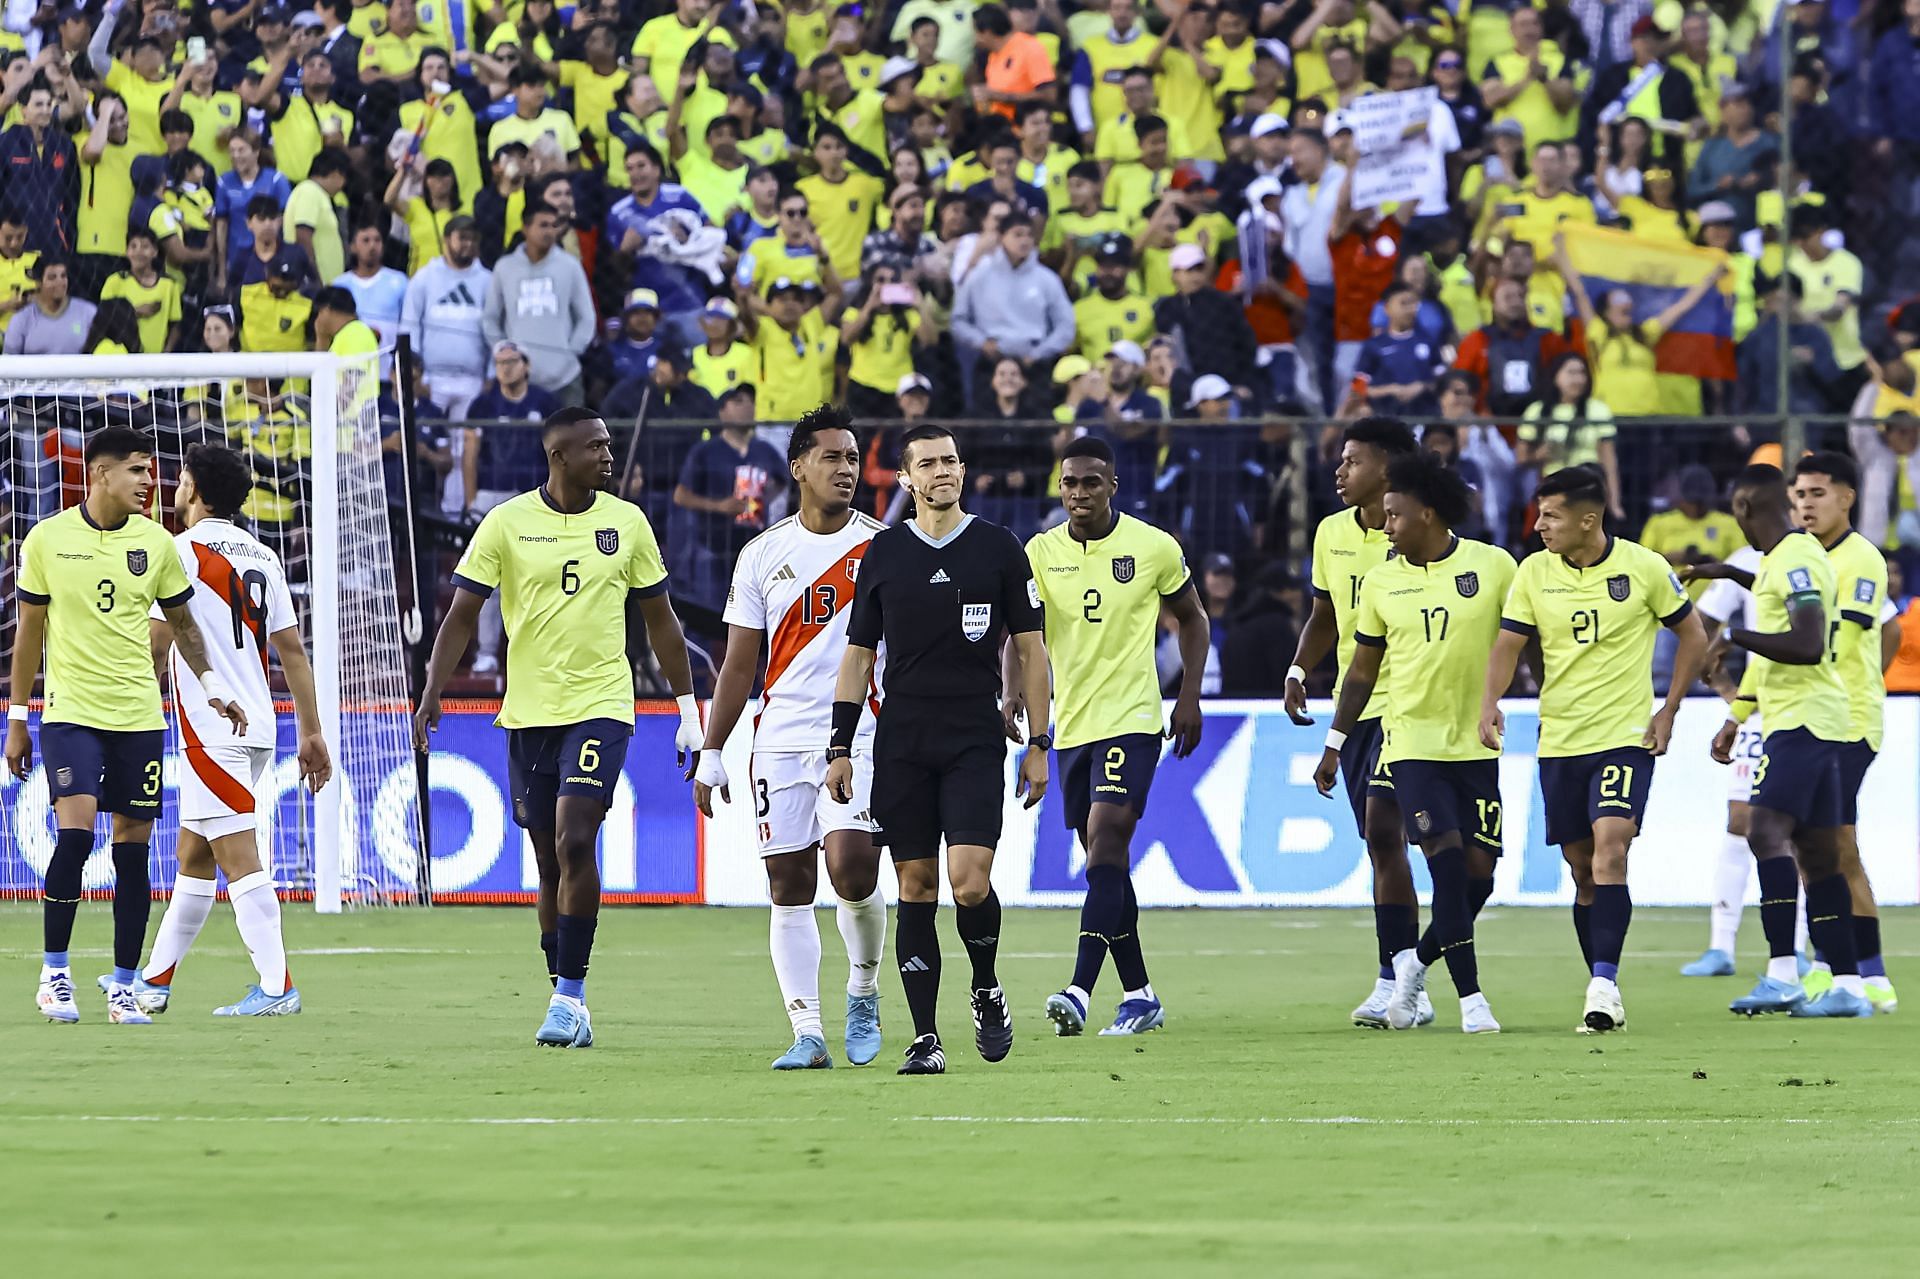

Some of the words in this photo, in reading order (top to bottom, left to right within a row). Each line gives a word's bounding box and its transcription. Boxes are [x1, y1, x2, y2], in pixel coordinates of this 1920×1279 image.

[561, 560, 581, 596] 6
[97, 579, 116, 613] 3
[228, 568, 269, 656] 19
[802, 585, 837, 625] 13
[965, 606, 988, 617] FIFA
[1083, 588, 1102, 623] 2
[1420, 606, 1449, 643] 17
[1571, 609, 1599, 644] 21
[578, 738, 602, 773] 6
[1104, 746, 1126, 781] 2
[142, 760, 161, 796] 3
[565, 776, 604, 788] marathon
[1600, 765, 1634, 798] 21
[1475, 799, 1502, 837] 17
